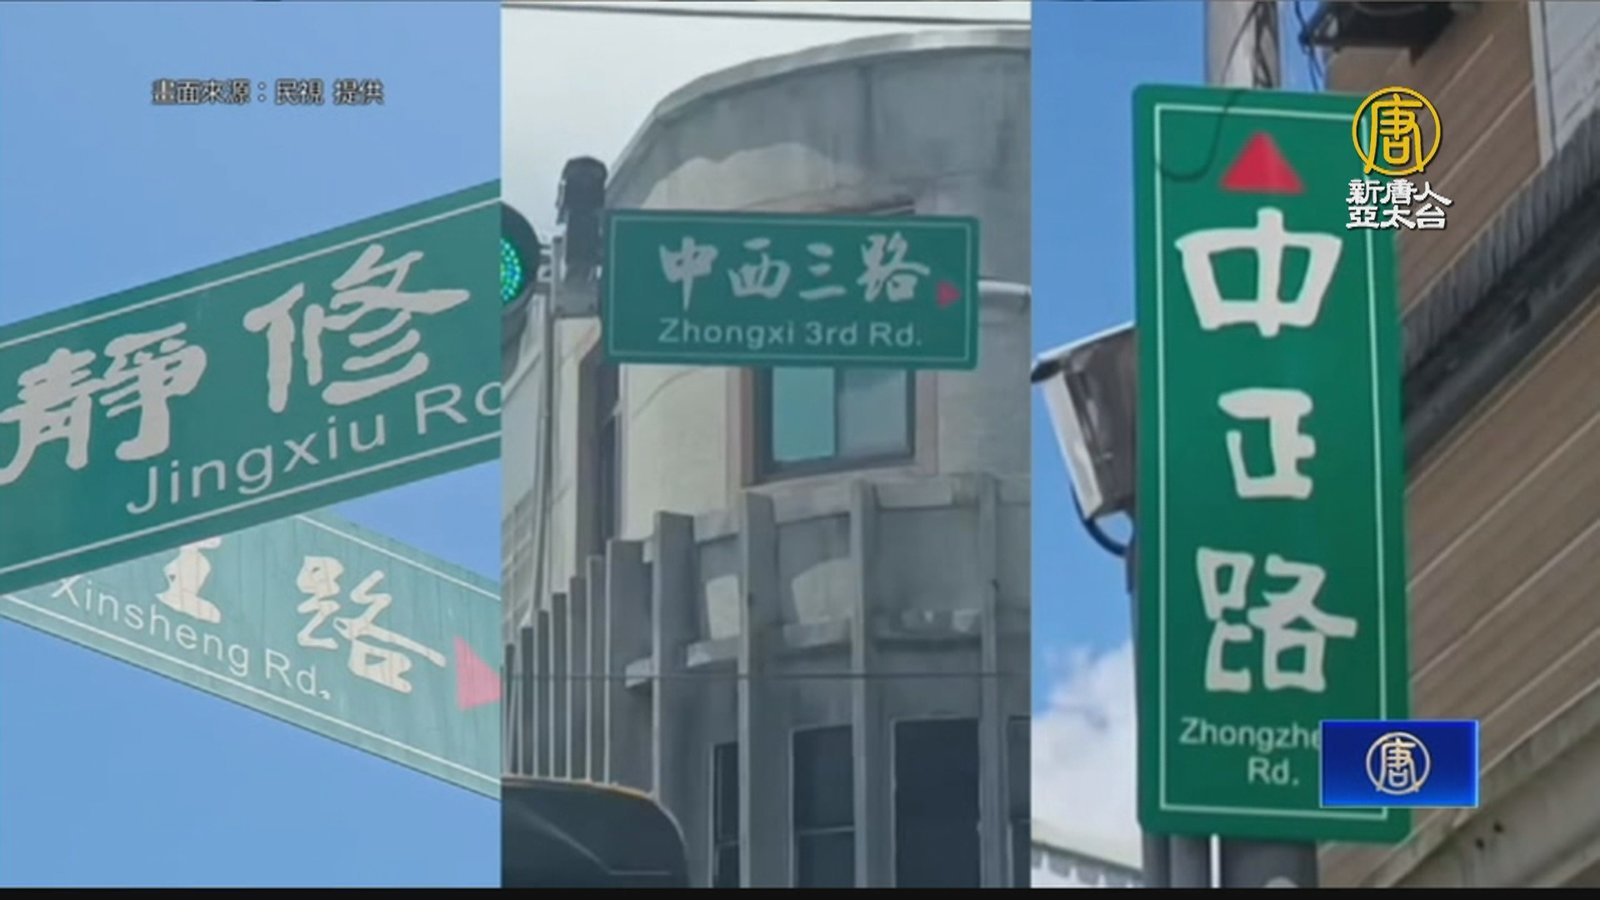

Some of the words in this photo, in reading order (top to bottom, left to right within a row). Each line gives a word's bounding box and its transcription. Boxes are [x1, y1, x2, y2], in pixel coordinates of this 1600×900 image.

[658, 231, 930, 311] 中西三路
[657, 317, 795, 350] Zhongxi
[805, 322, 858, 346] 3rd
[869, 323, 923, 348] Rd.
[126, 414, 386, 514] Jingxiu
[1174, 207, 1358, 694] 中正路
[51, 574, 250, 677] Xinsheng
[264, 650, 332, 701] Rd.
[1248, 756, 1299, 786] Rd.
